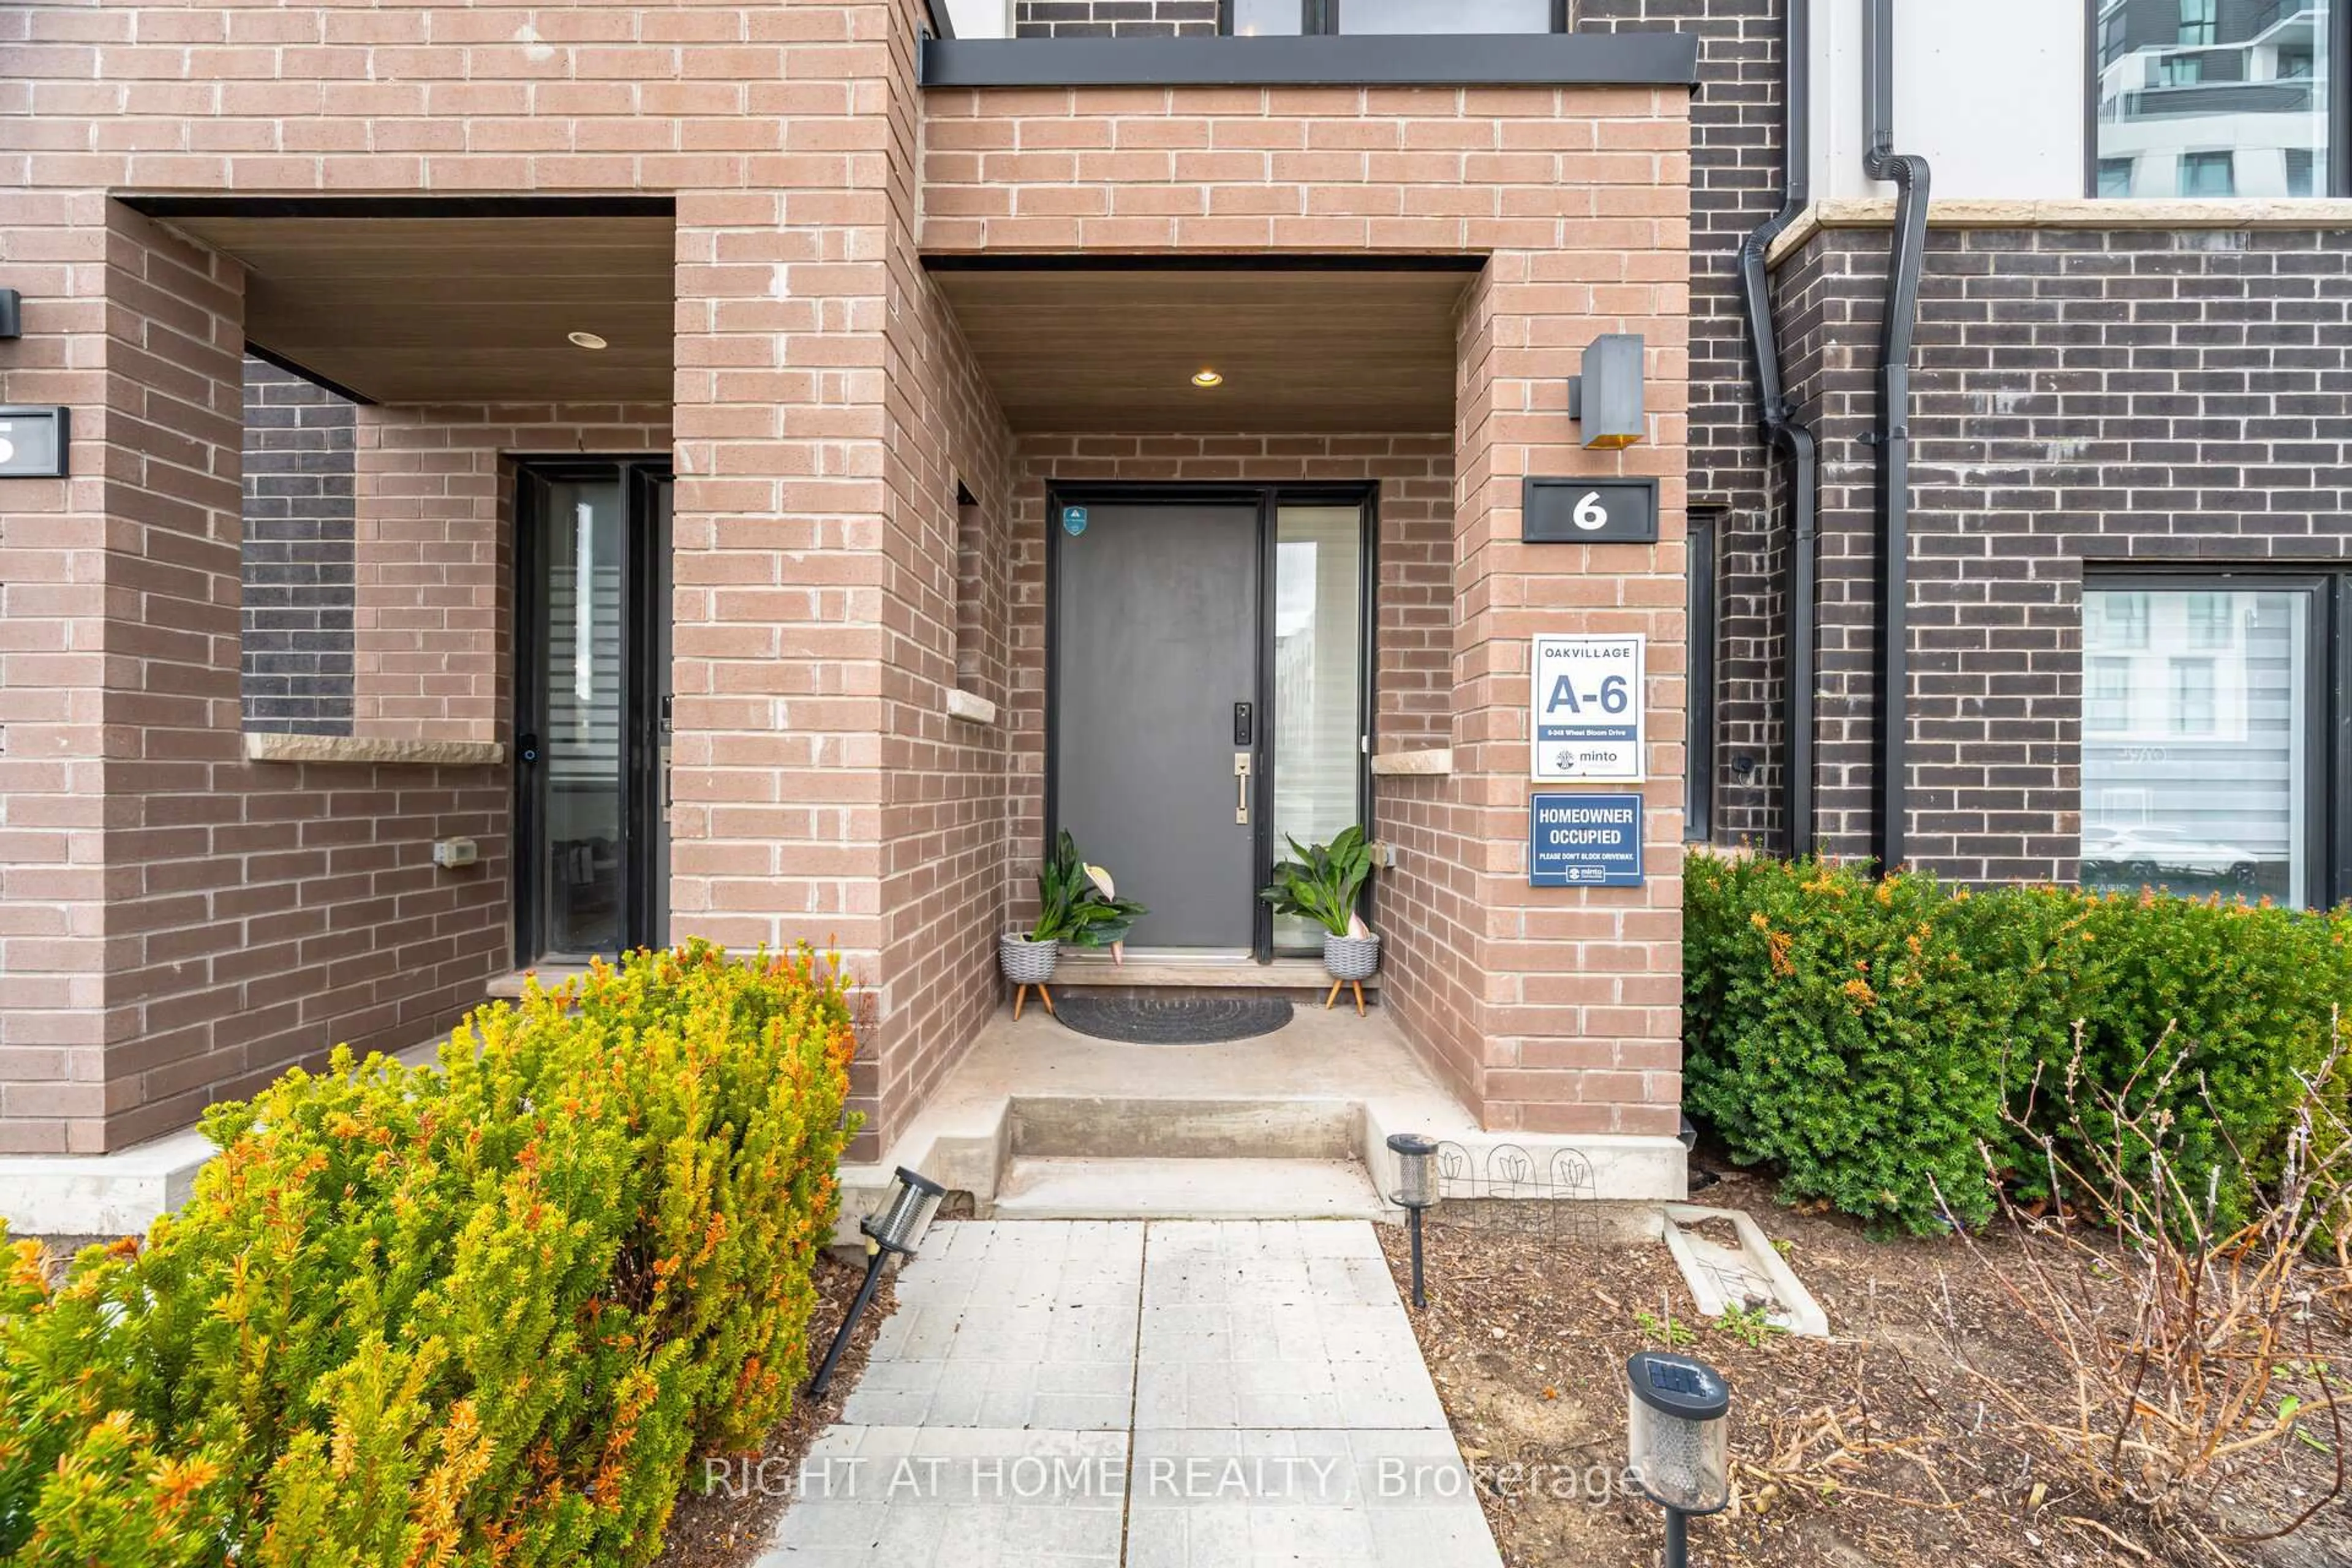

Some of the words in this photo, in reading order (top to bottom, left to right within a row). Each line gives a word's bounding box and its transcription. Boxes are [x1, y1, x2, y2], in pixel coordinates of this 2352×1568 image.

[1573, 491, 1608, 530] 6
[1545, 647, 1630, 658] OAKVILLAGE
[1546, 674, 1627, 714] A-6
[1580, 750, 1618, 762] minto
[1539, 809, 1634, 824] HOMEOWNER
[1550, 829, 1621, 844] OCCUPIED
